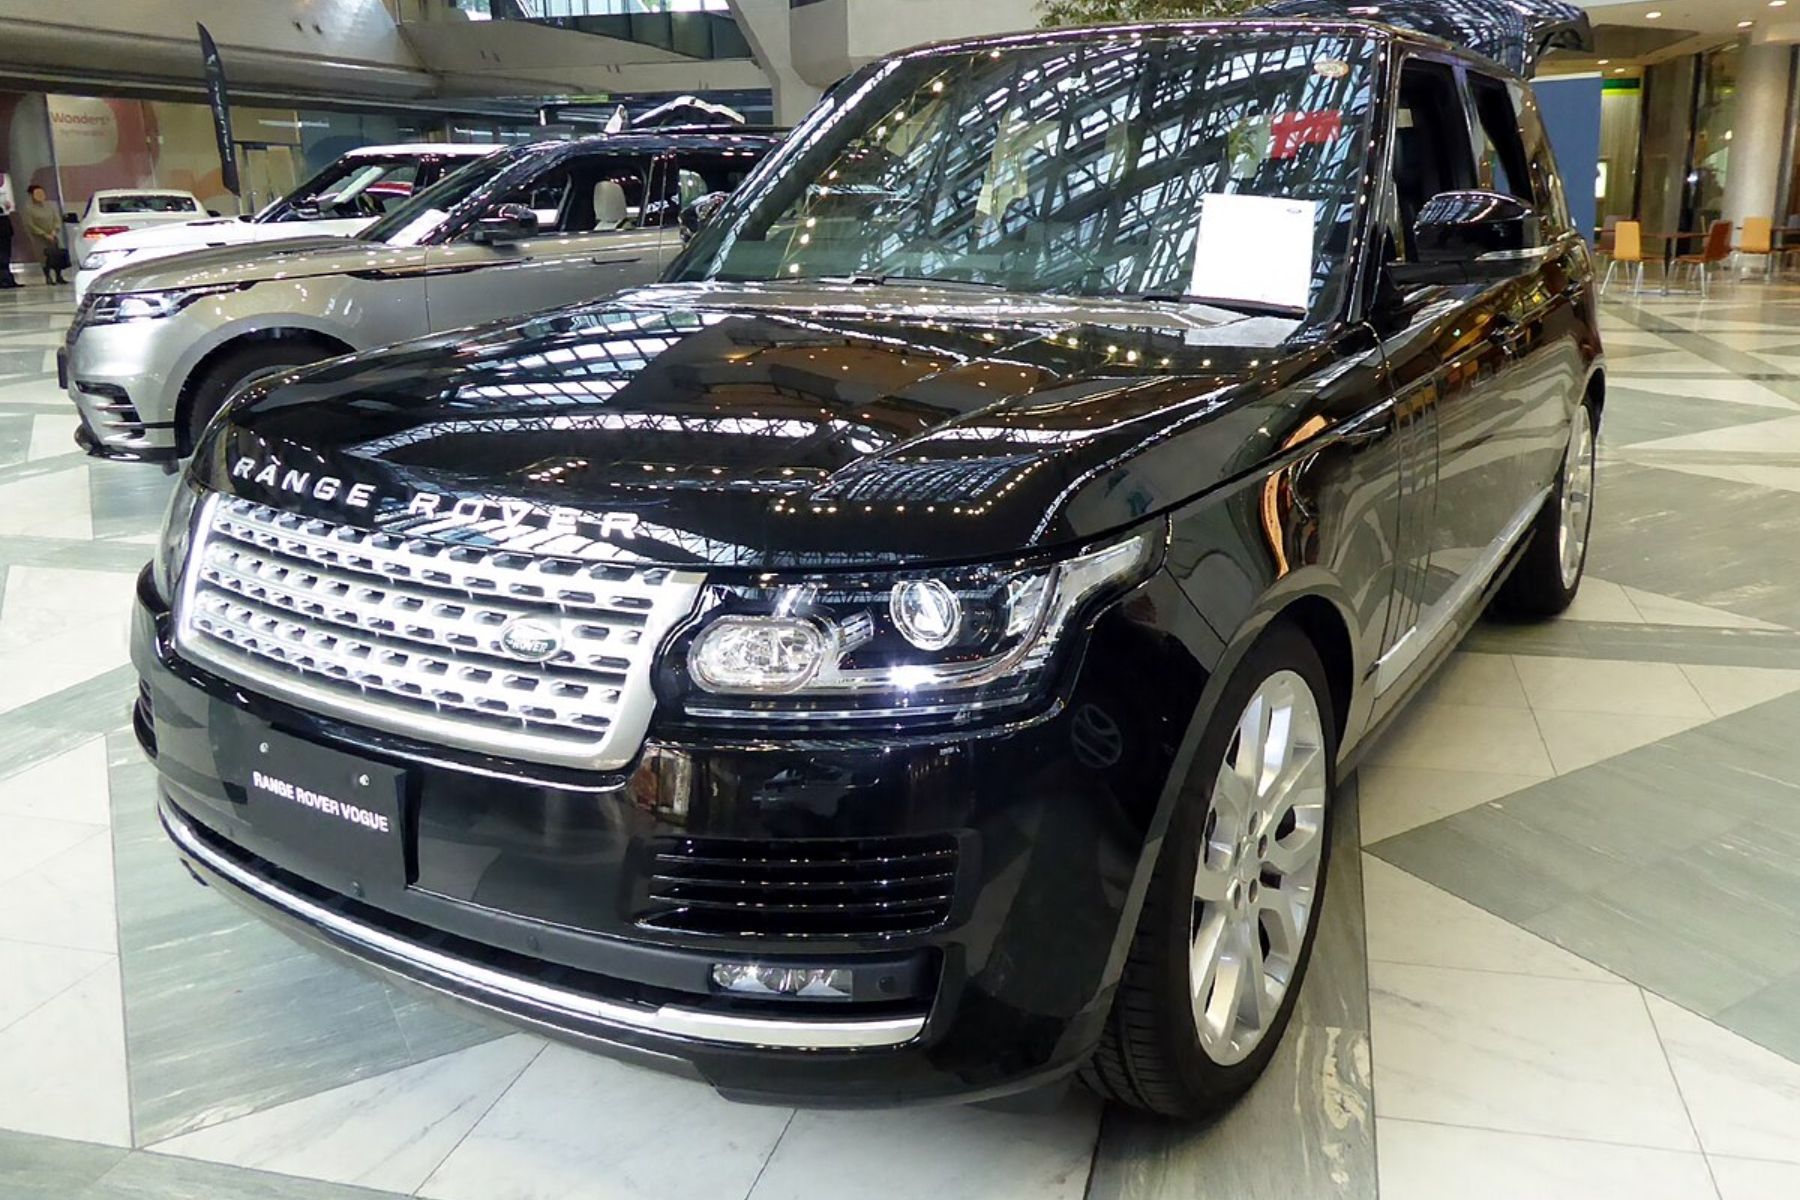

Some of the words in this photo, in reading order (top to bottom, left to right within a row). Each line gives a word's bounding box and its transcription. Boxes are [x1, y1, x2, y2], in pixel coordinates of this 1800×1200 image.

[233, 457, 377, 508] RANGE
[408, 493, 639, 540] ROVER
[253, 771, 295, 800] RANGE
[296, 786, 340, 816] ROVER
[340, 803, 389, 832] VOGUE
